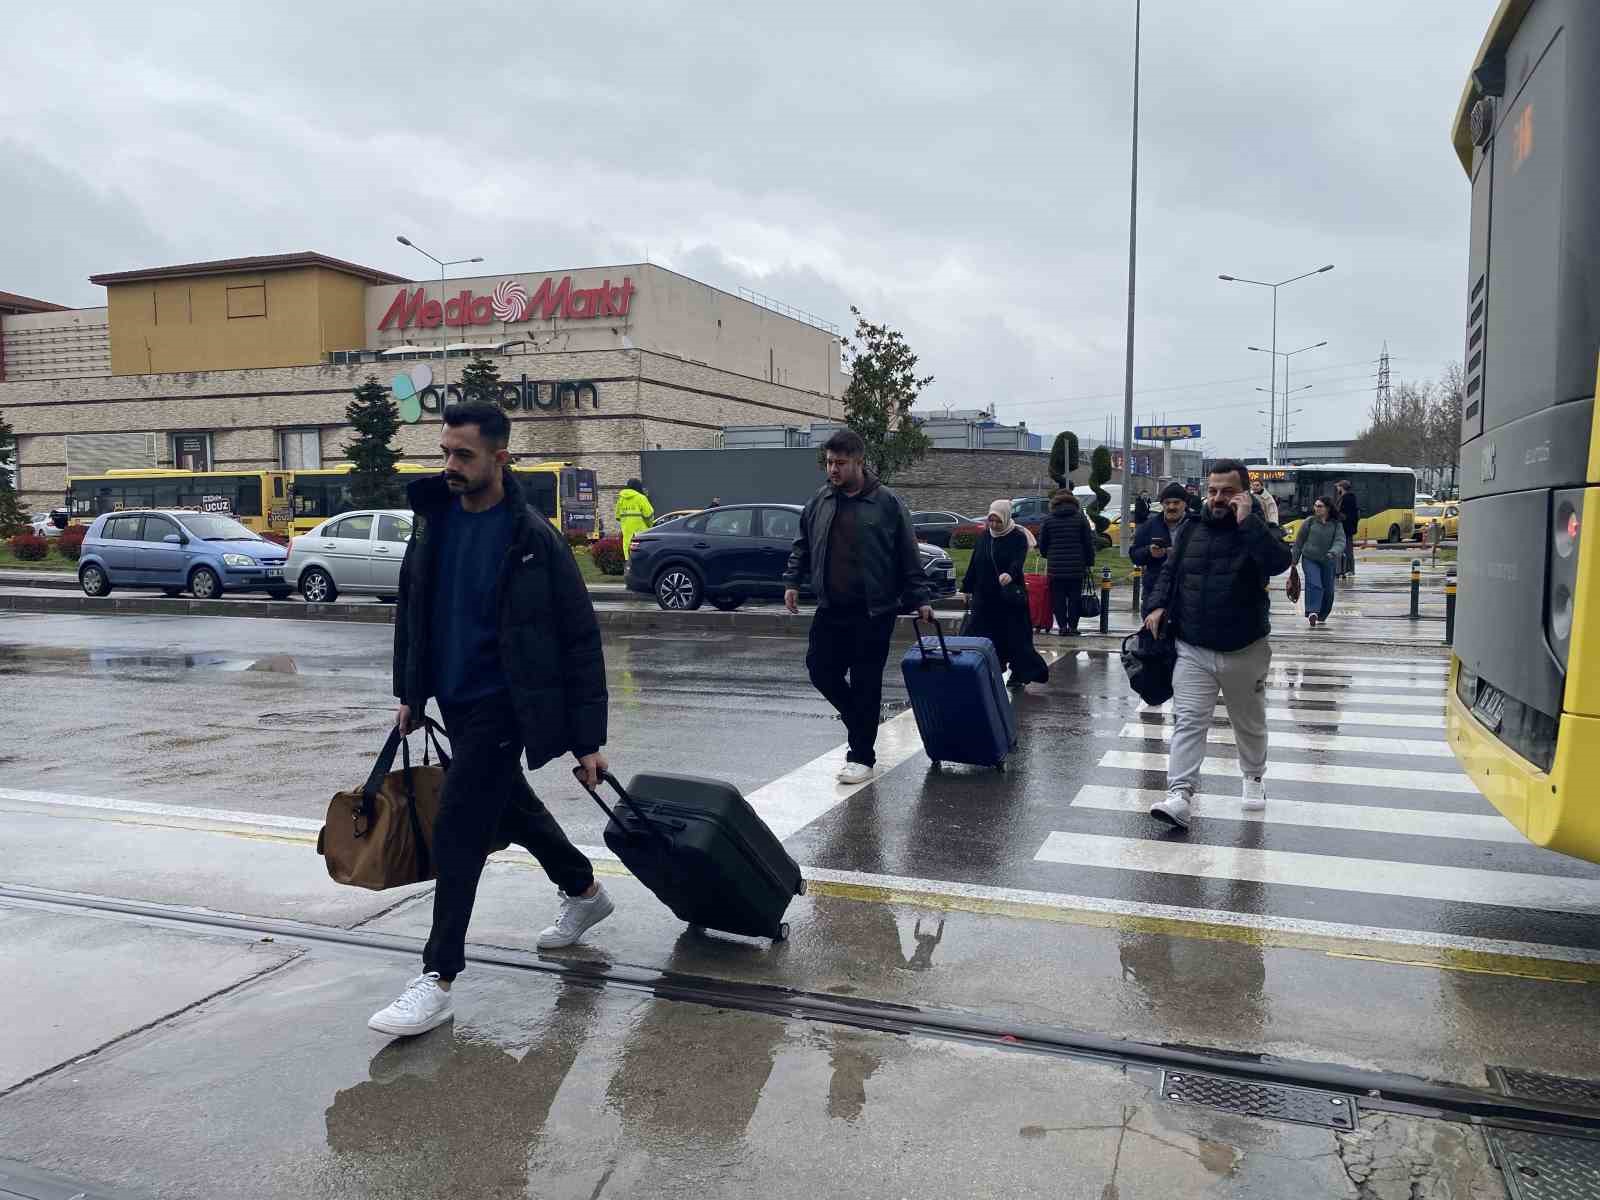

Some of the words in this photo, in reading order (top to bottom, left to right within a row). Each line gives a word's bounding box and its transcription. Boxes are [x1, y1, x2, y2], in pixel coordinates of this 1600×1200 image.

[378, 288, 494, 329] Media
[521, 276, 635, 319] Markt
[1142, 426, 1192, 437] IKEA
